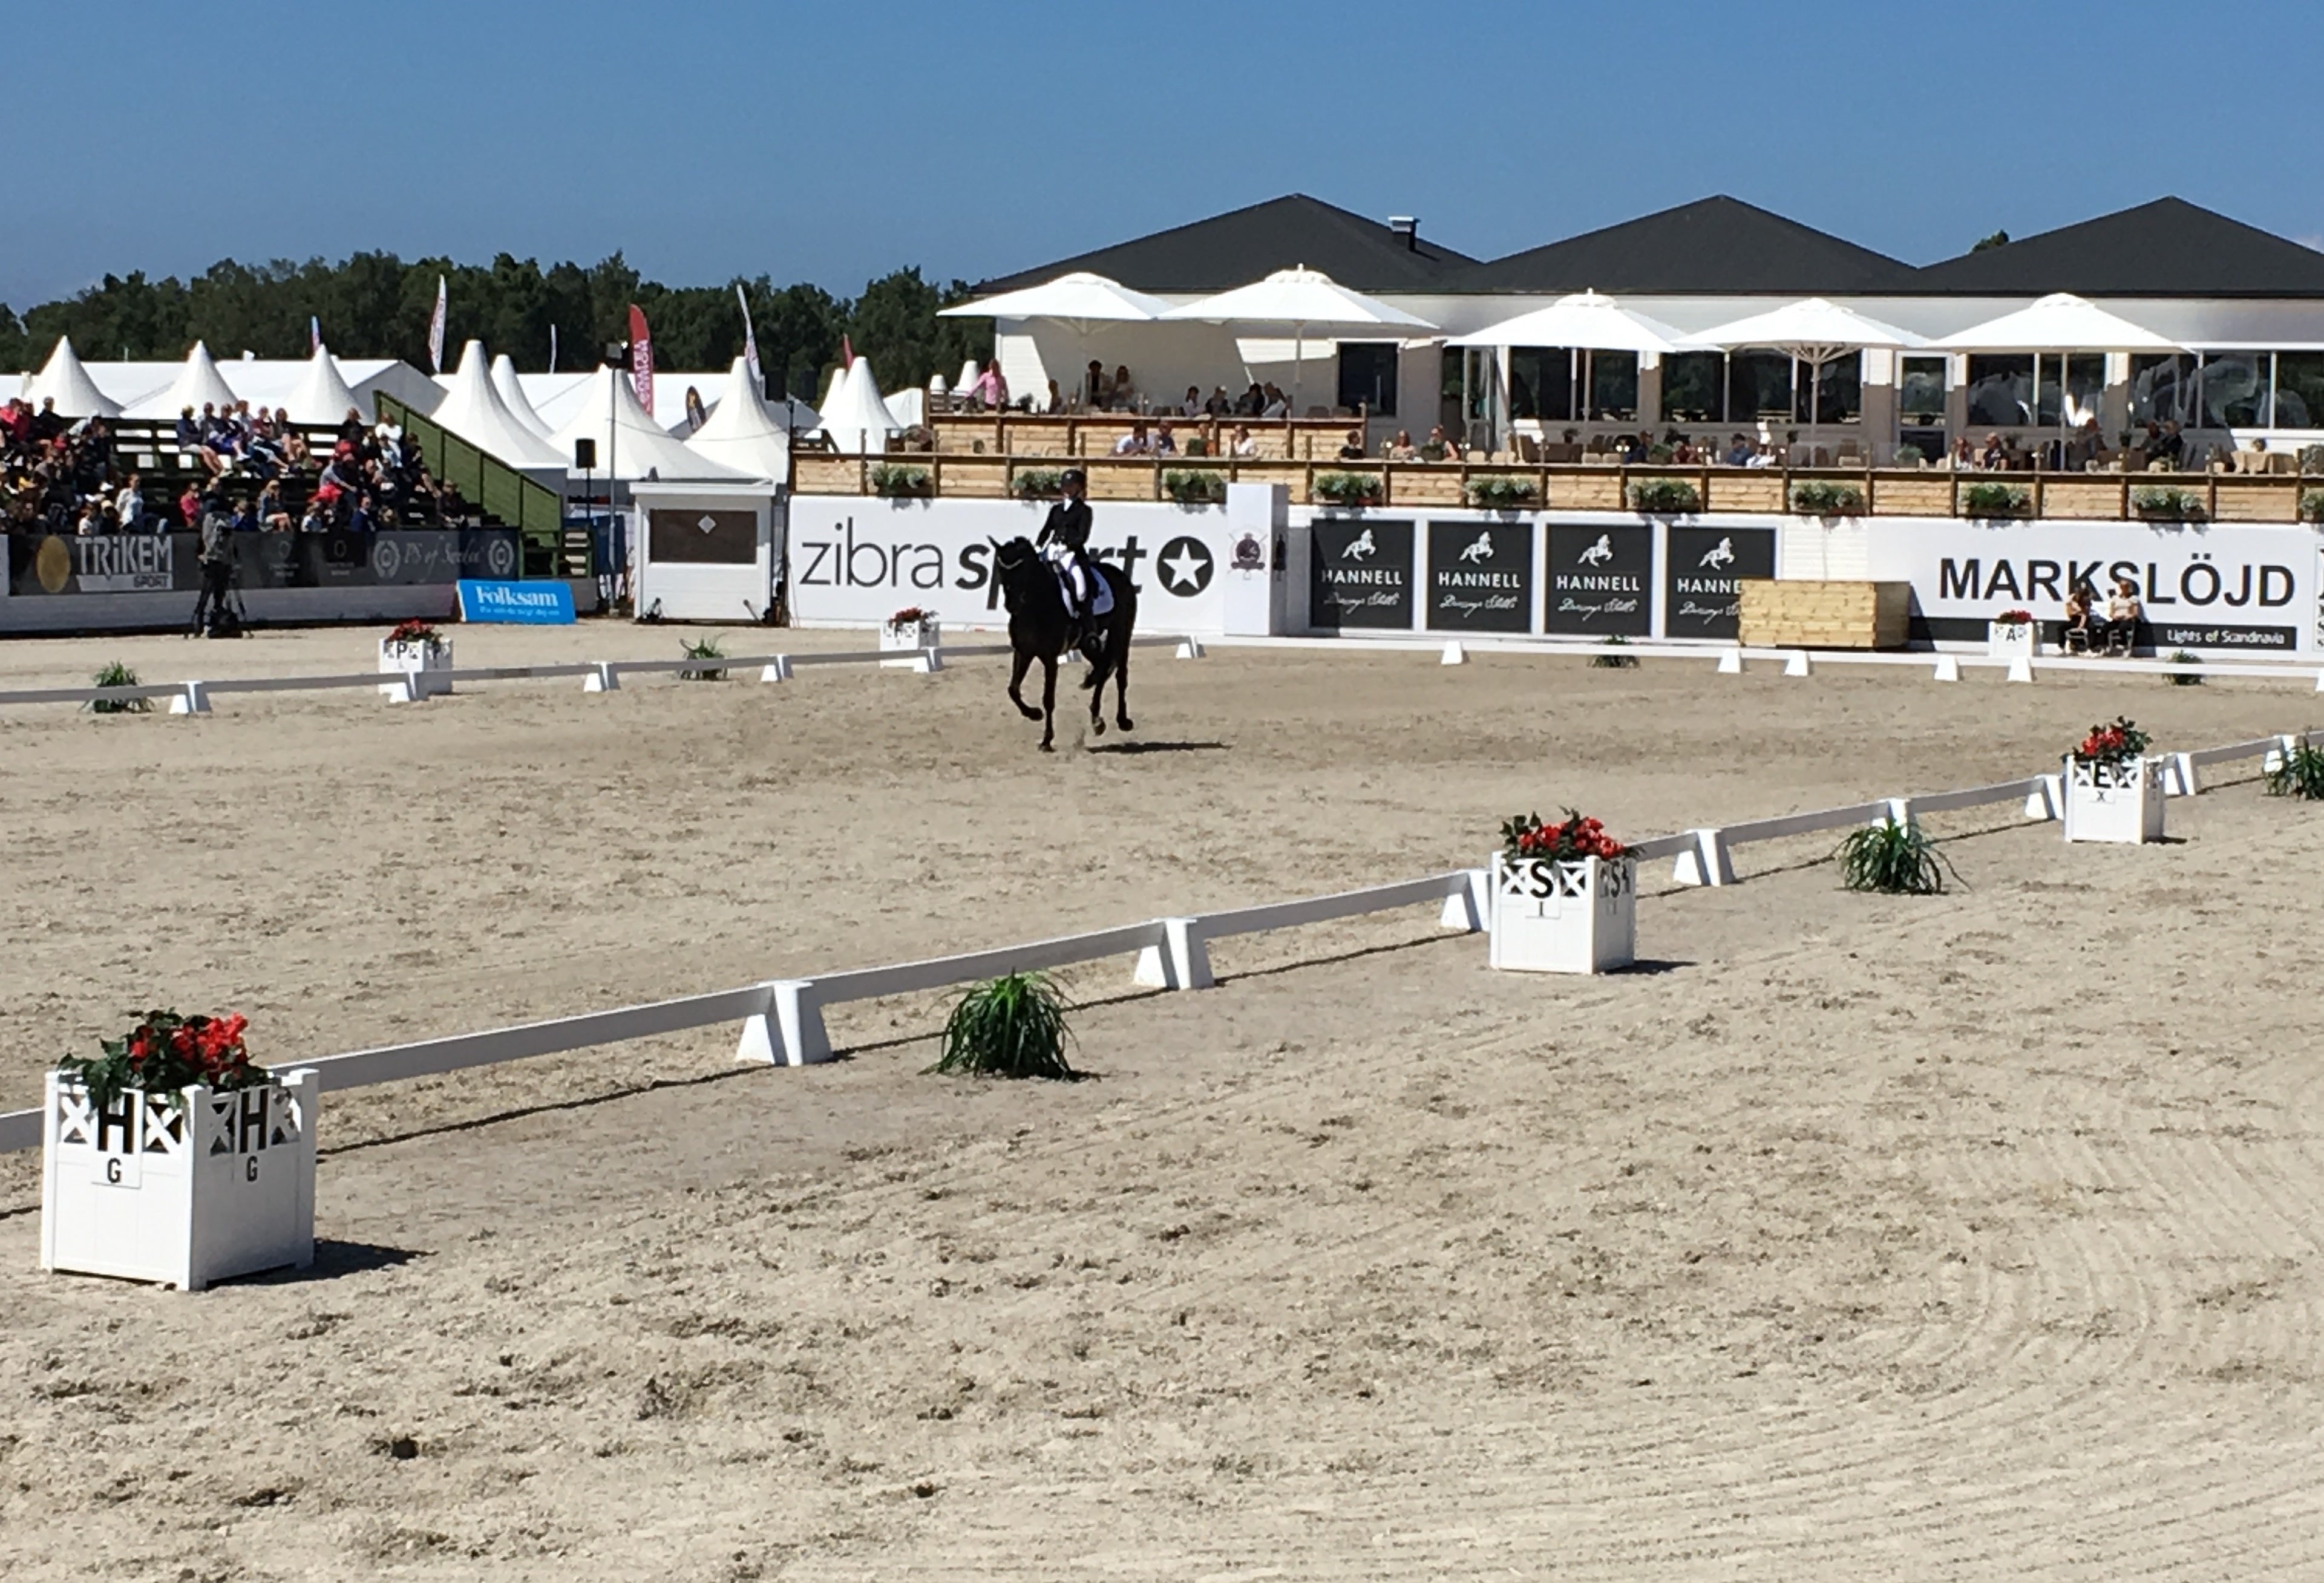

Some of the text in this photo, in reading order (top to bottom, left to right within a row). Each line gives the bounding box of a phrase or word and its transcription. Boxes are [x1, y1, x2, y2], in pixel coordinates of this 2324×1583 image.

[133, 575, 168, 588] SPORT
[1321, 569, 1403, 586] HANNELL
[1438, 572, 1521, 589] HANNELL
[1556, 575, 1640, 592] HANNELL
[1677, 577, 1741, 595] HANNE
[1940, 553, 2295, 607] MARKSLÖJD
[475, 586, 558, 607] Folksam
[2006, 627, 2016, 641] A
[2166, 629, 2285, 644] Lights of Scandinavia
[396, 641, 407, 660] P
[2093, 762, 2112, 789] E
[2097, 791, 2106, 802] X
[1530, 860, 1554, 899] S
[1610, 860, 1621, 898] S
[97, 1092, 134, 1155] H
[238, 1088, 270, 1154] H
[107, 1158, 122, 1184] G
[246, 1155, 258, 1182] G
